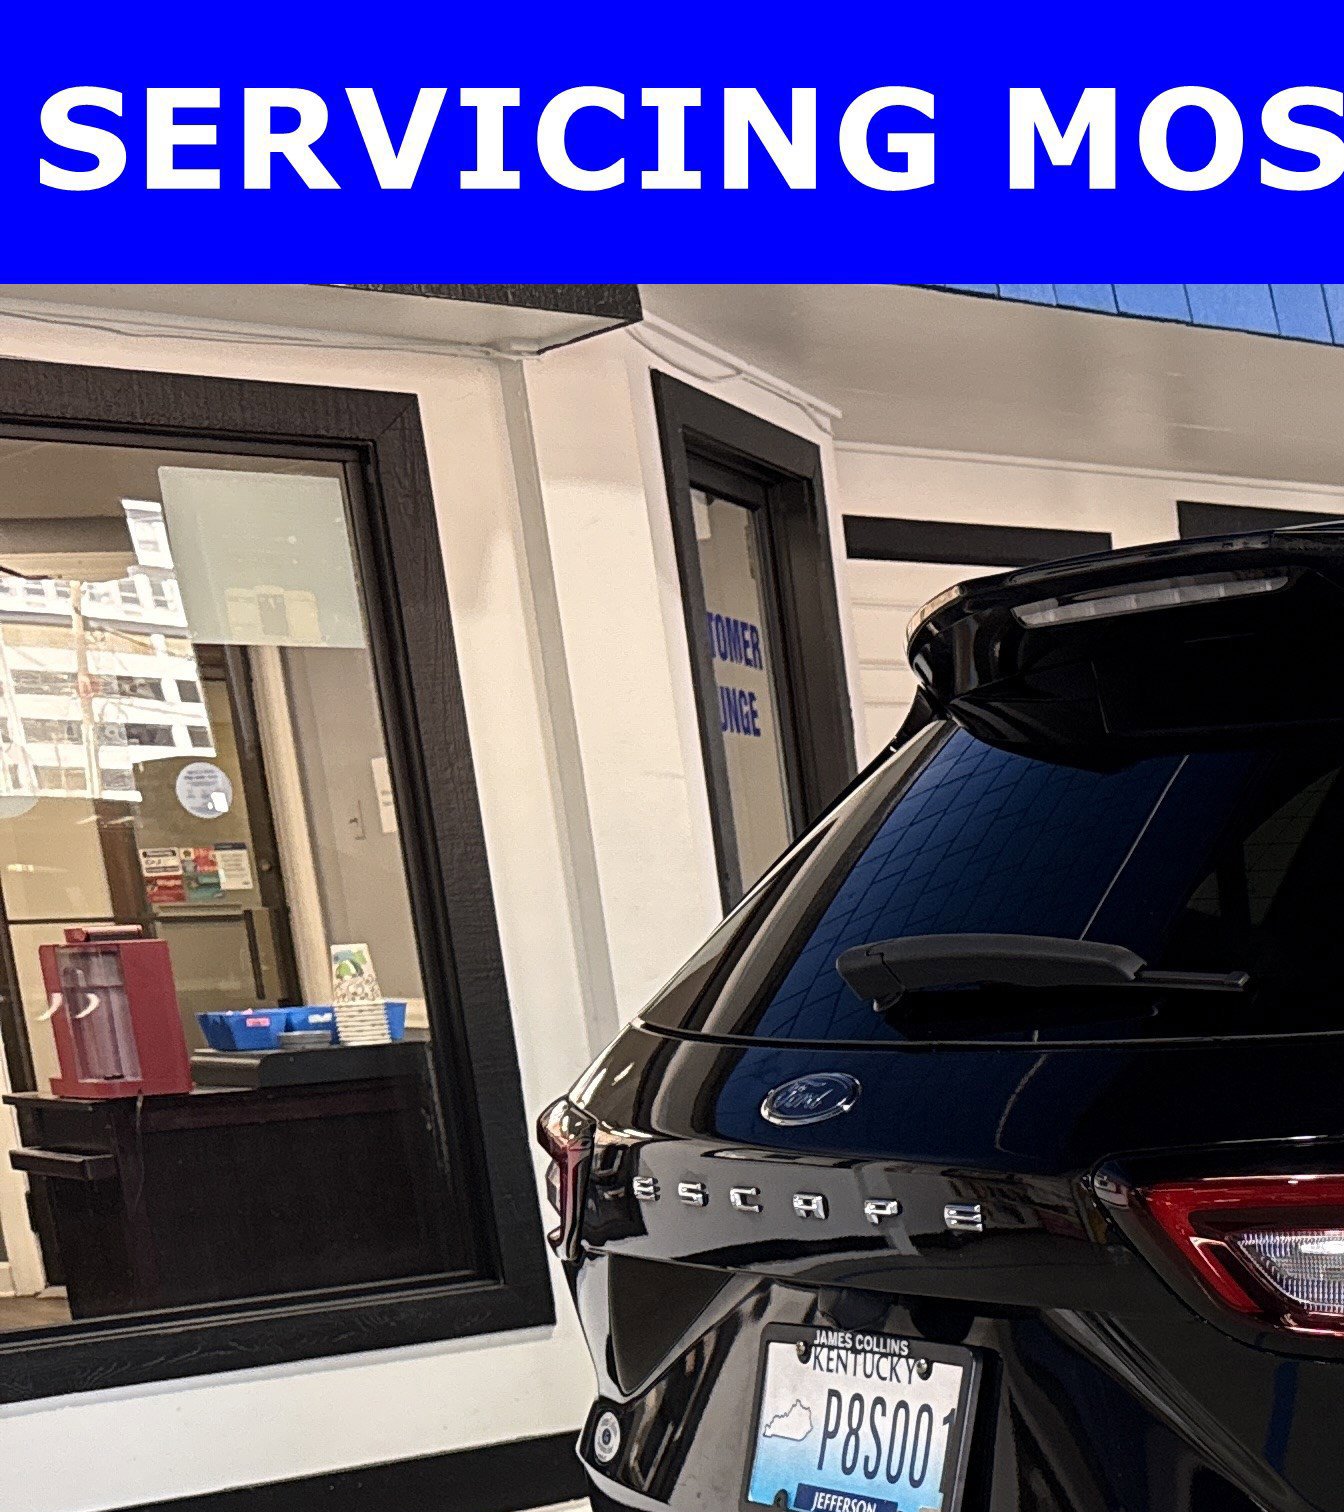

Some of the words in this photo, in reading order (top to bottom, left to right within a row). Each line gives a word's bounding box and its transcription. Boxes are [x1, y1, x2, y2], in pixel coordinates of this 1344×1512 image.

[633, 1176, 984, 1232] ESCAPE
[812, 1347, 917, 1385] KENTUCKY
[813, 1329, 853, 1350] JAMES
[855, 1334, 909, 1357] COLLINS
[817, 1388, 957, 1489] P8S00
